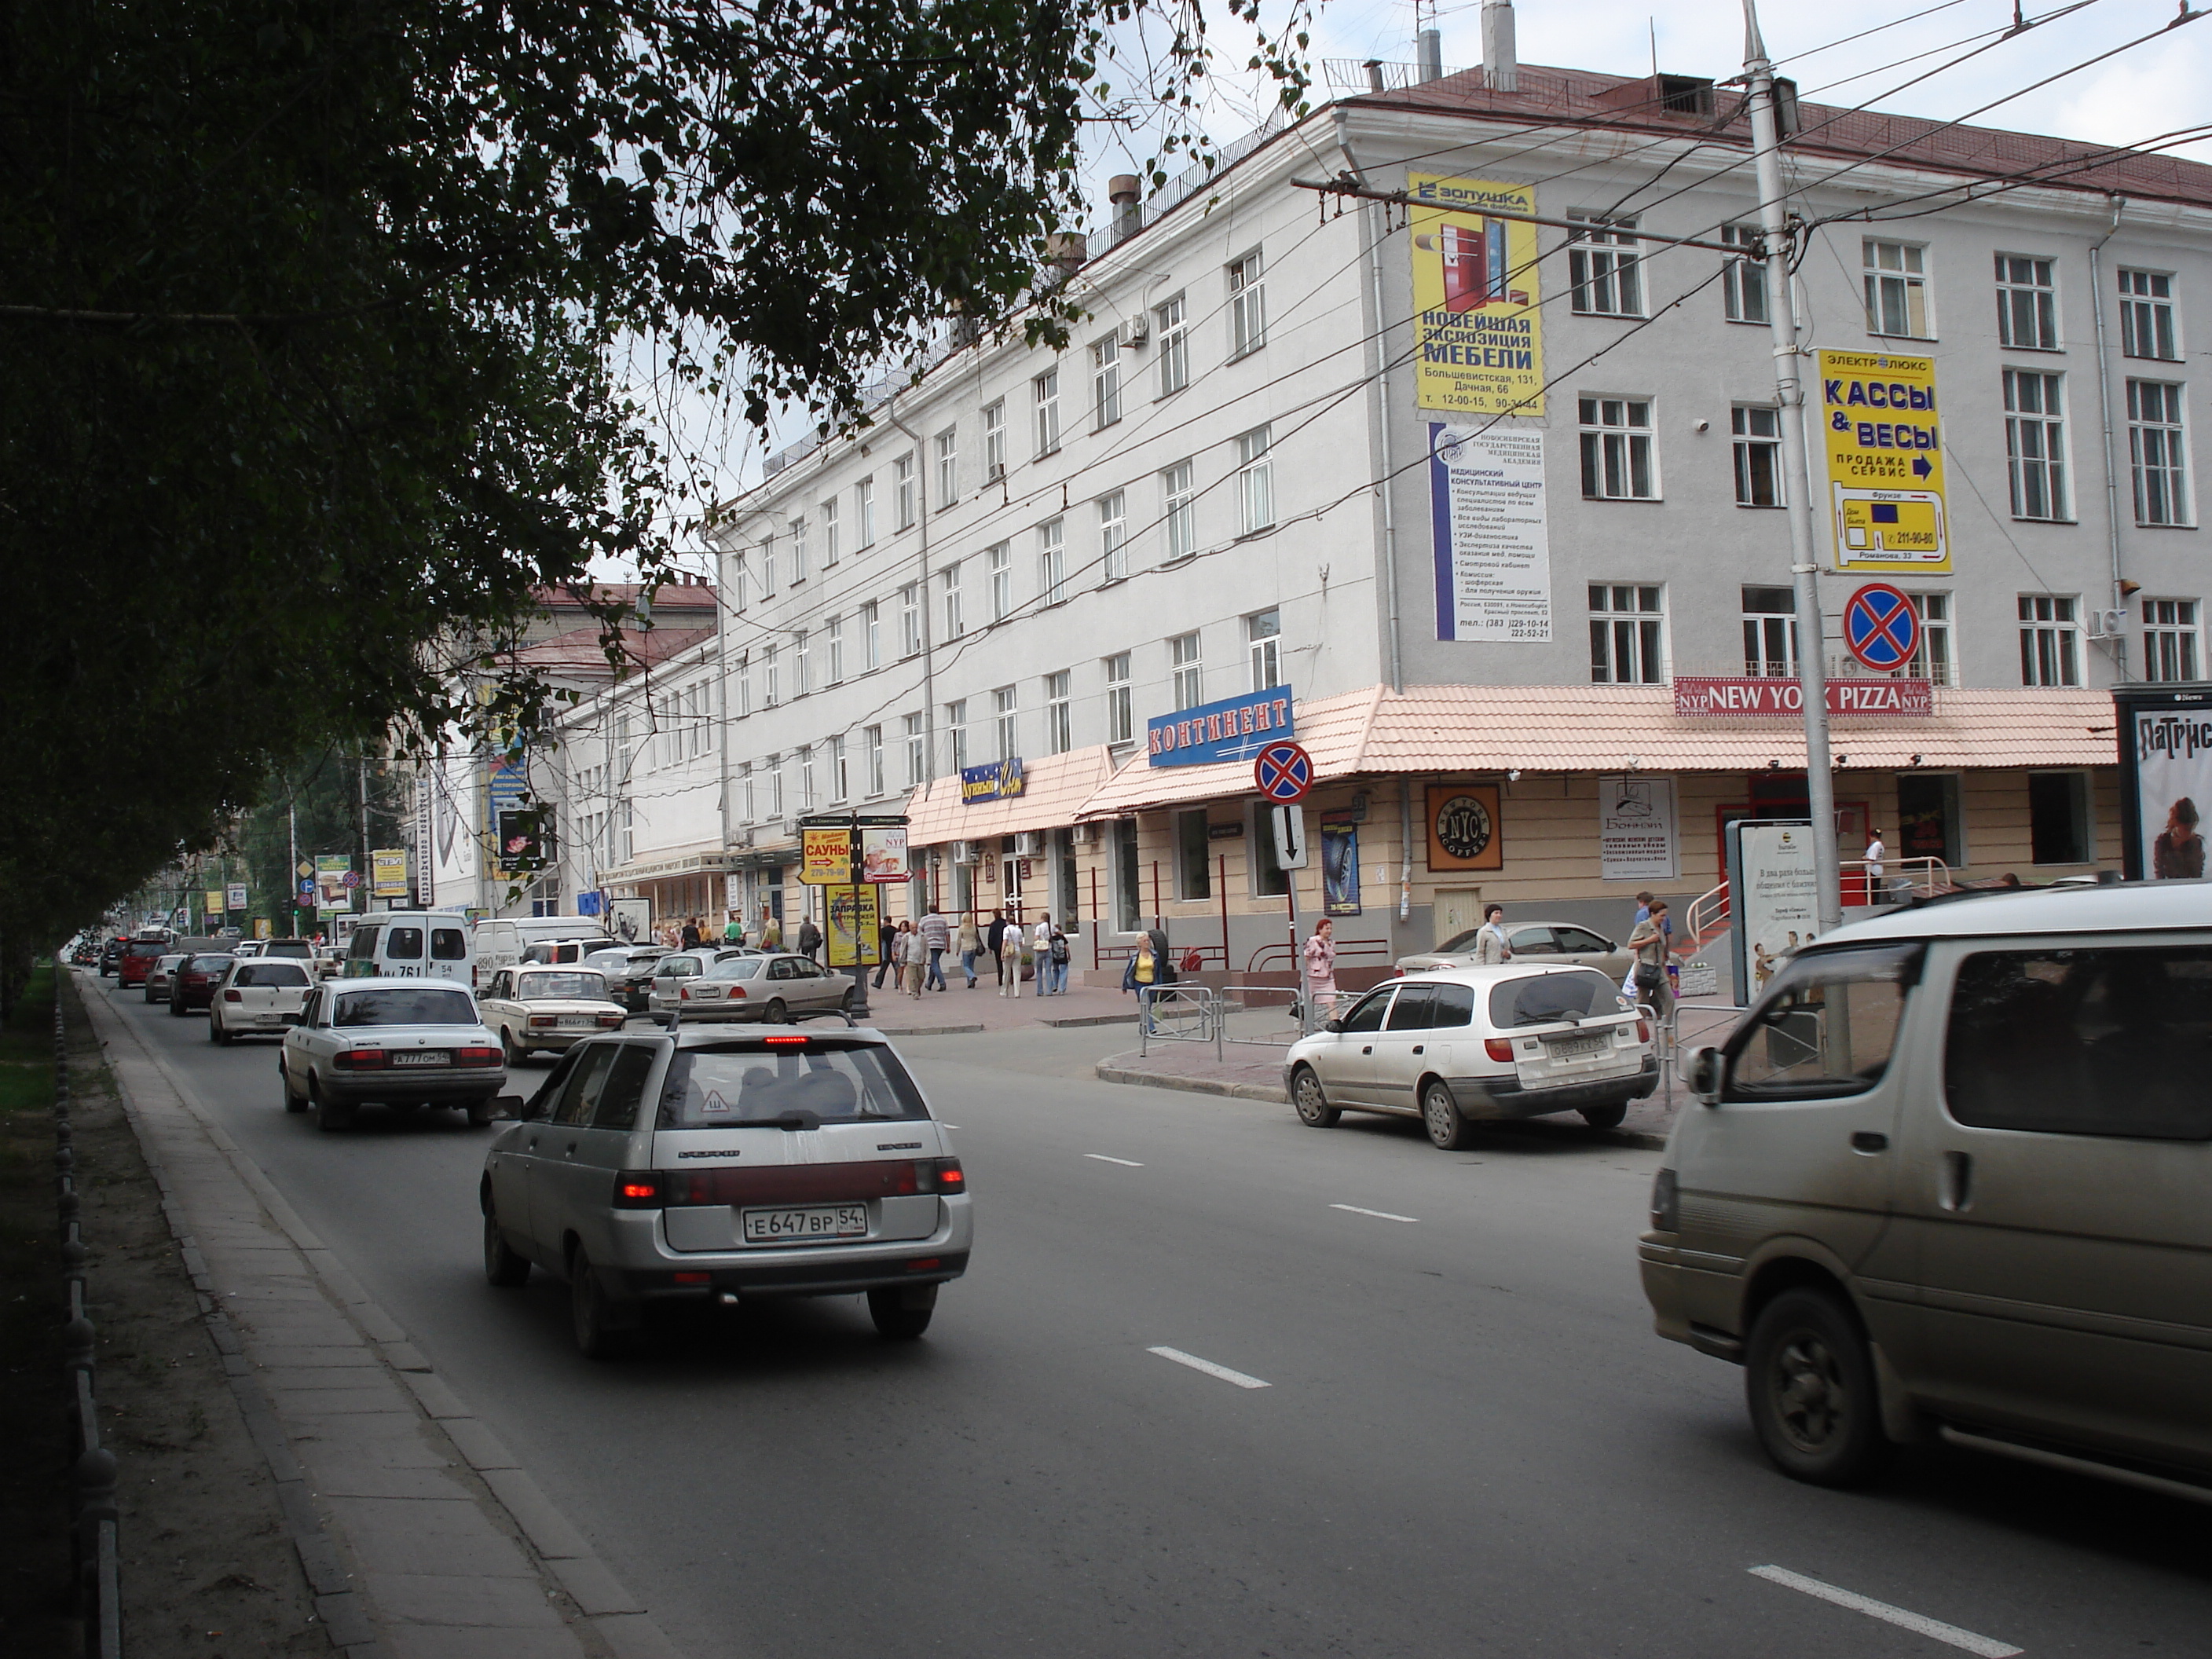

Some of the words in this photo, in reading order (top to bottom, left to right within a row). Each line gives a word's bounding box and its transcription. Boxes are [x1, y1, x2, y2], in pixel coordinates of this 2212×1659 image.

[1440, 187, 1528, 205] ЗОЛУШКА
[1423, 309, 1531, 333] НОВЕЙШАЯ
[1423, 328, 1531, 348] ЭКСПОЗИЦИЯ
[1424, 342, 1532, 370] МЕБЕЛИ
[1425, 367, 1514, 384] Большевистская,
[1518, 375, 1537, 386] 131,
[1455, 381, 1495, 394] Дачная,
[1497, 385, 1508, 394] 66
[1825, 379, 1935, 411] КАССЫ
[1831, 411, 1851, 432] &
[1857, 422, 1939, 451] ВЕСЫ
[1837, 454, 1905, 467] ПРОДАЖА
[1451, 468, 1503, 477] МЕДИЦИНСКИЙ
[1851, 466, 1906, 478] СЕРВИС
[1451, 478, 1520, 488] КОНСУЛЬТАТИВНЫЙ
[1679, 695, 1708, 707] NYP
[1708, 686, 1763, 709] NEW
[1769, 686, 1832, 709] YOK
[1840, 686, 1901, 709] PIZZA
[1902, 696, 1928, 708] NYP
[1149, 698, 1287, 755] КОНТИНЕНТ
[1450, 811, 1478, 842] NYC
[806, 844, 848, 855] САУНЫ
[1442, 838, 1485, 856] COFFEE
[839, 1210, 859, 1224] 54
